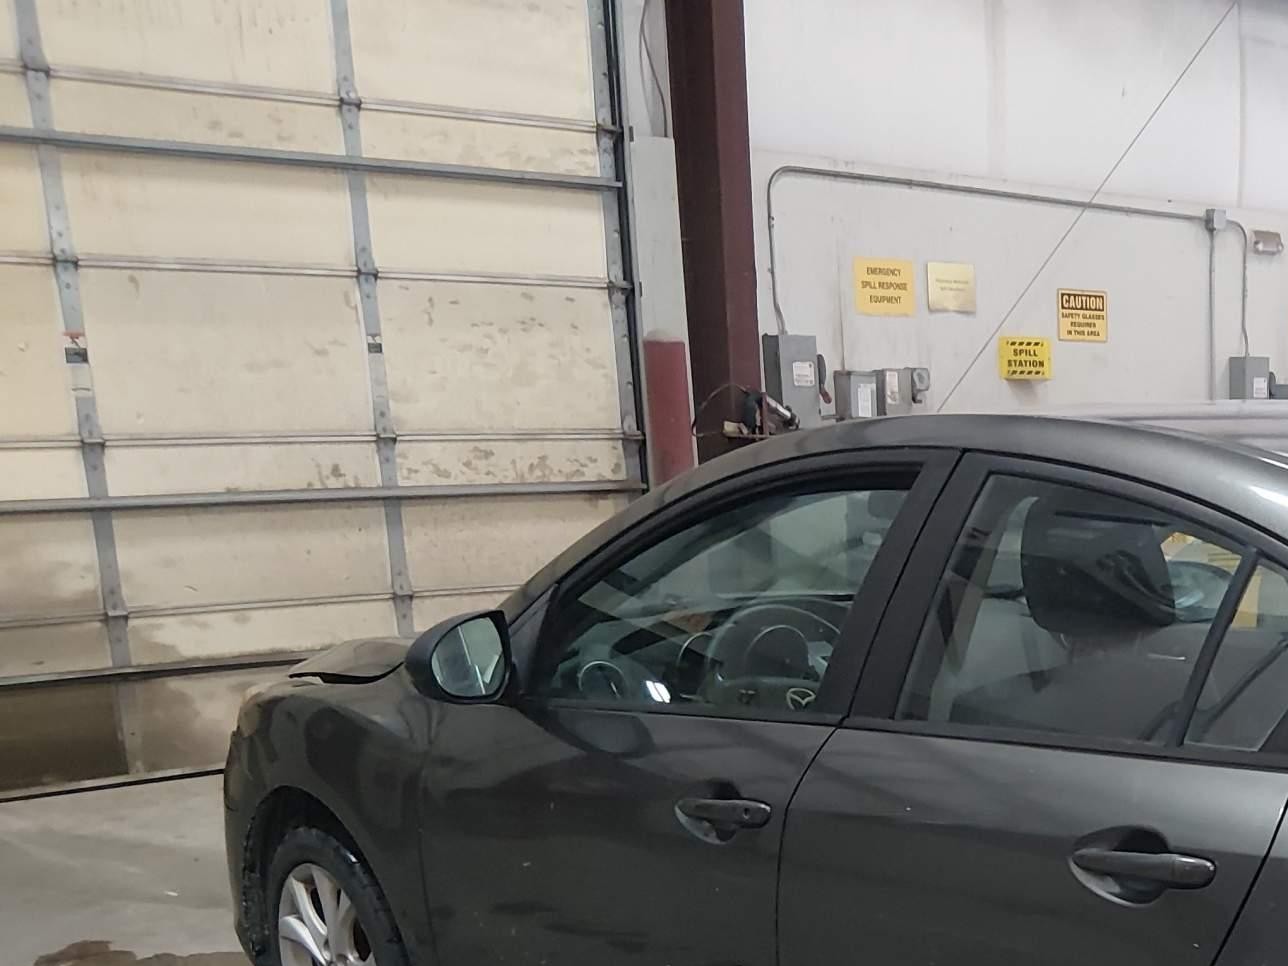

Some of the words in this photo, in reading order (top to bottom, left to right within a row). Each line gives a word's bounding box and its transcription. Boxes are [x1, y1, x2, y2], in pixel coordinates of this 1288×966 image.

[866, 267, 900, 276] EMERGENCY
[861, 280, 877, 290] SPILL
[878, 281, 908, 291] RESPONSE
[869, 295, 902, 304] EQUIPMENT
[1062, 295, 1103, 310] CAUTION
[1013, 348, 1038, 357] SPILL
[1007, 359, 1044, 368] STATION
